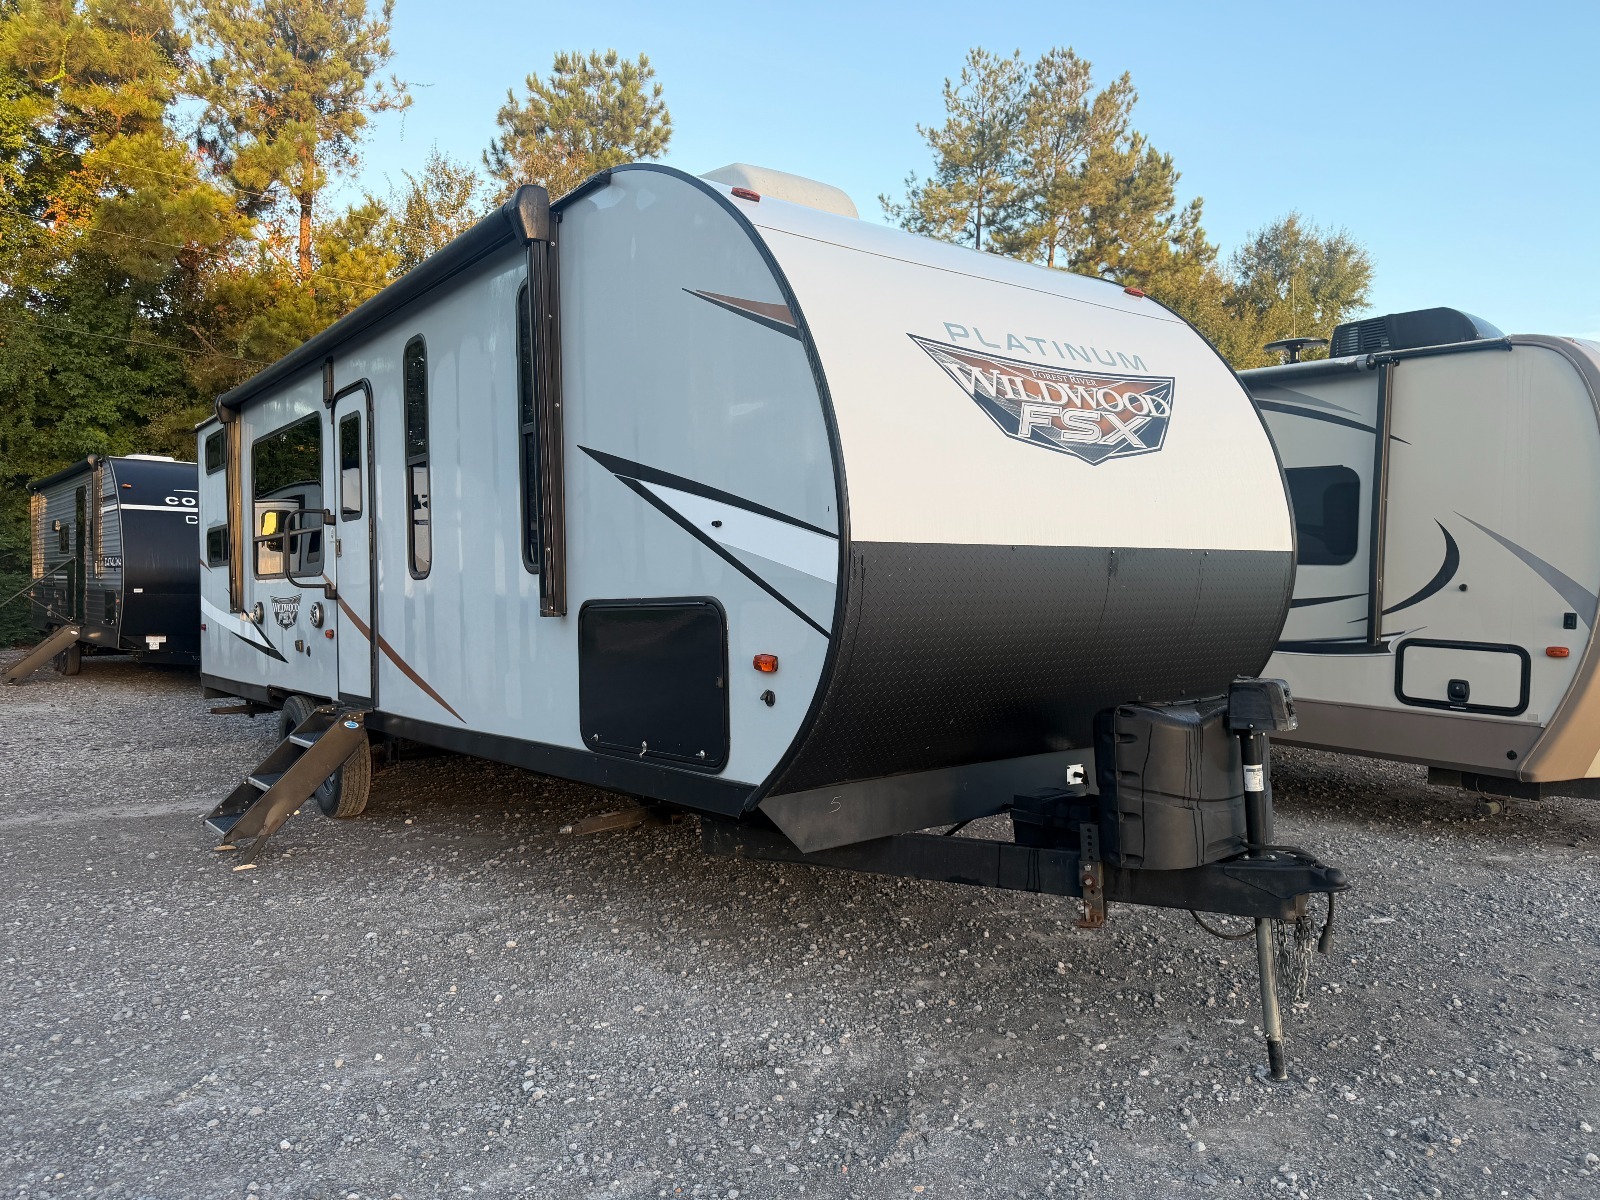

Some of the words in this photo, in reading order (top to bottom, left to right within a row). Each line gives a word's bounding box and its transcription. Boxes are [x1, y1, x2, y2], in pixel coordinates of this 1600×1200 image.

[943, 321, 1148, 372] PLATINUM
[945, 362, 1171, 418] WILDWOOD
[1031, 369, 1068, 383] FOREST
[1069, 375, 1098, 387] RIVER
[1018, 402, 1153, 449] FSX
